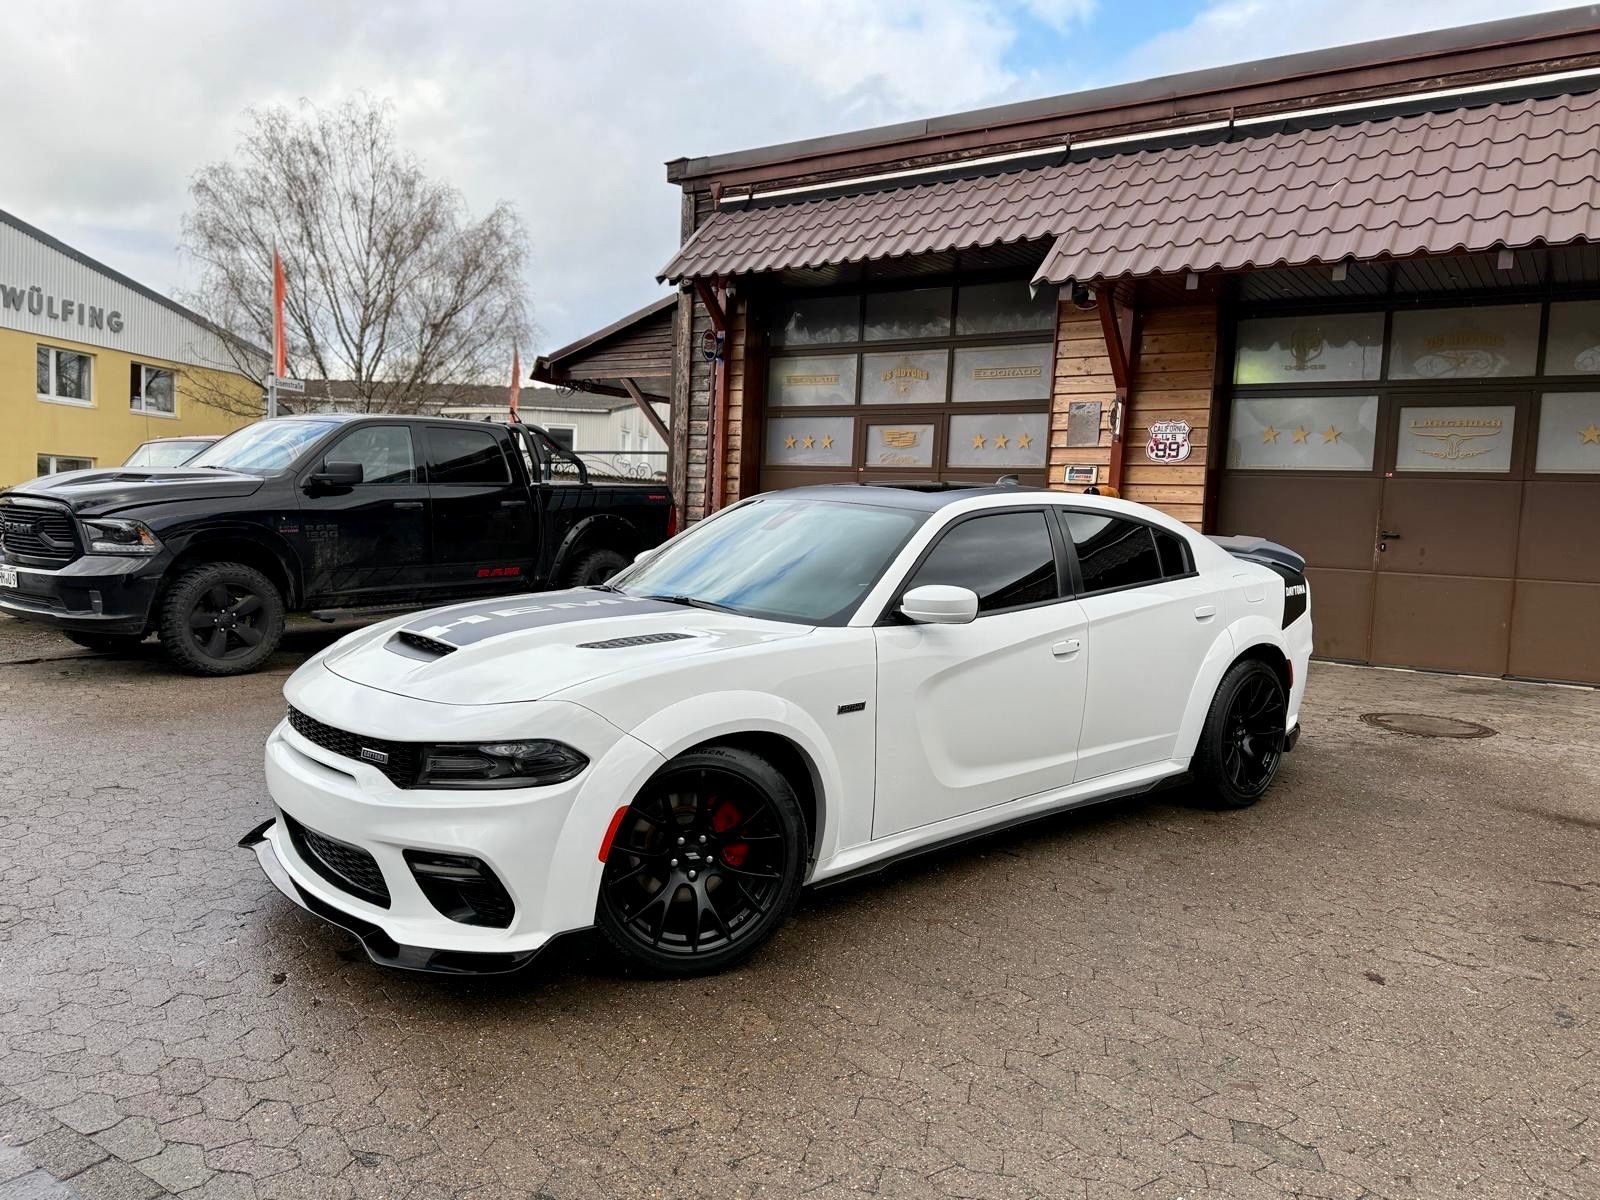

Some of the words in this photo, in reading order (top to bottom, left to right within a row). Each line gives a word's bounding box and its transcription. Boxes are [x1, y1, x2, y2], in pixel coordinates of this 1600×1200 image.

[0, 284, 124, 333] WÜLFING
[1153, 424, 1186, 433] CALIFORNIA
[1155, 442, 1180, 458] 99
[5, 522, 31, 534] RAM
[477, 567, 521, 577] RAM
[1286, 584, 1306, 597] DAYTONA
